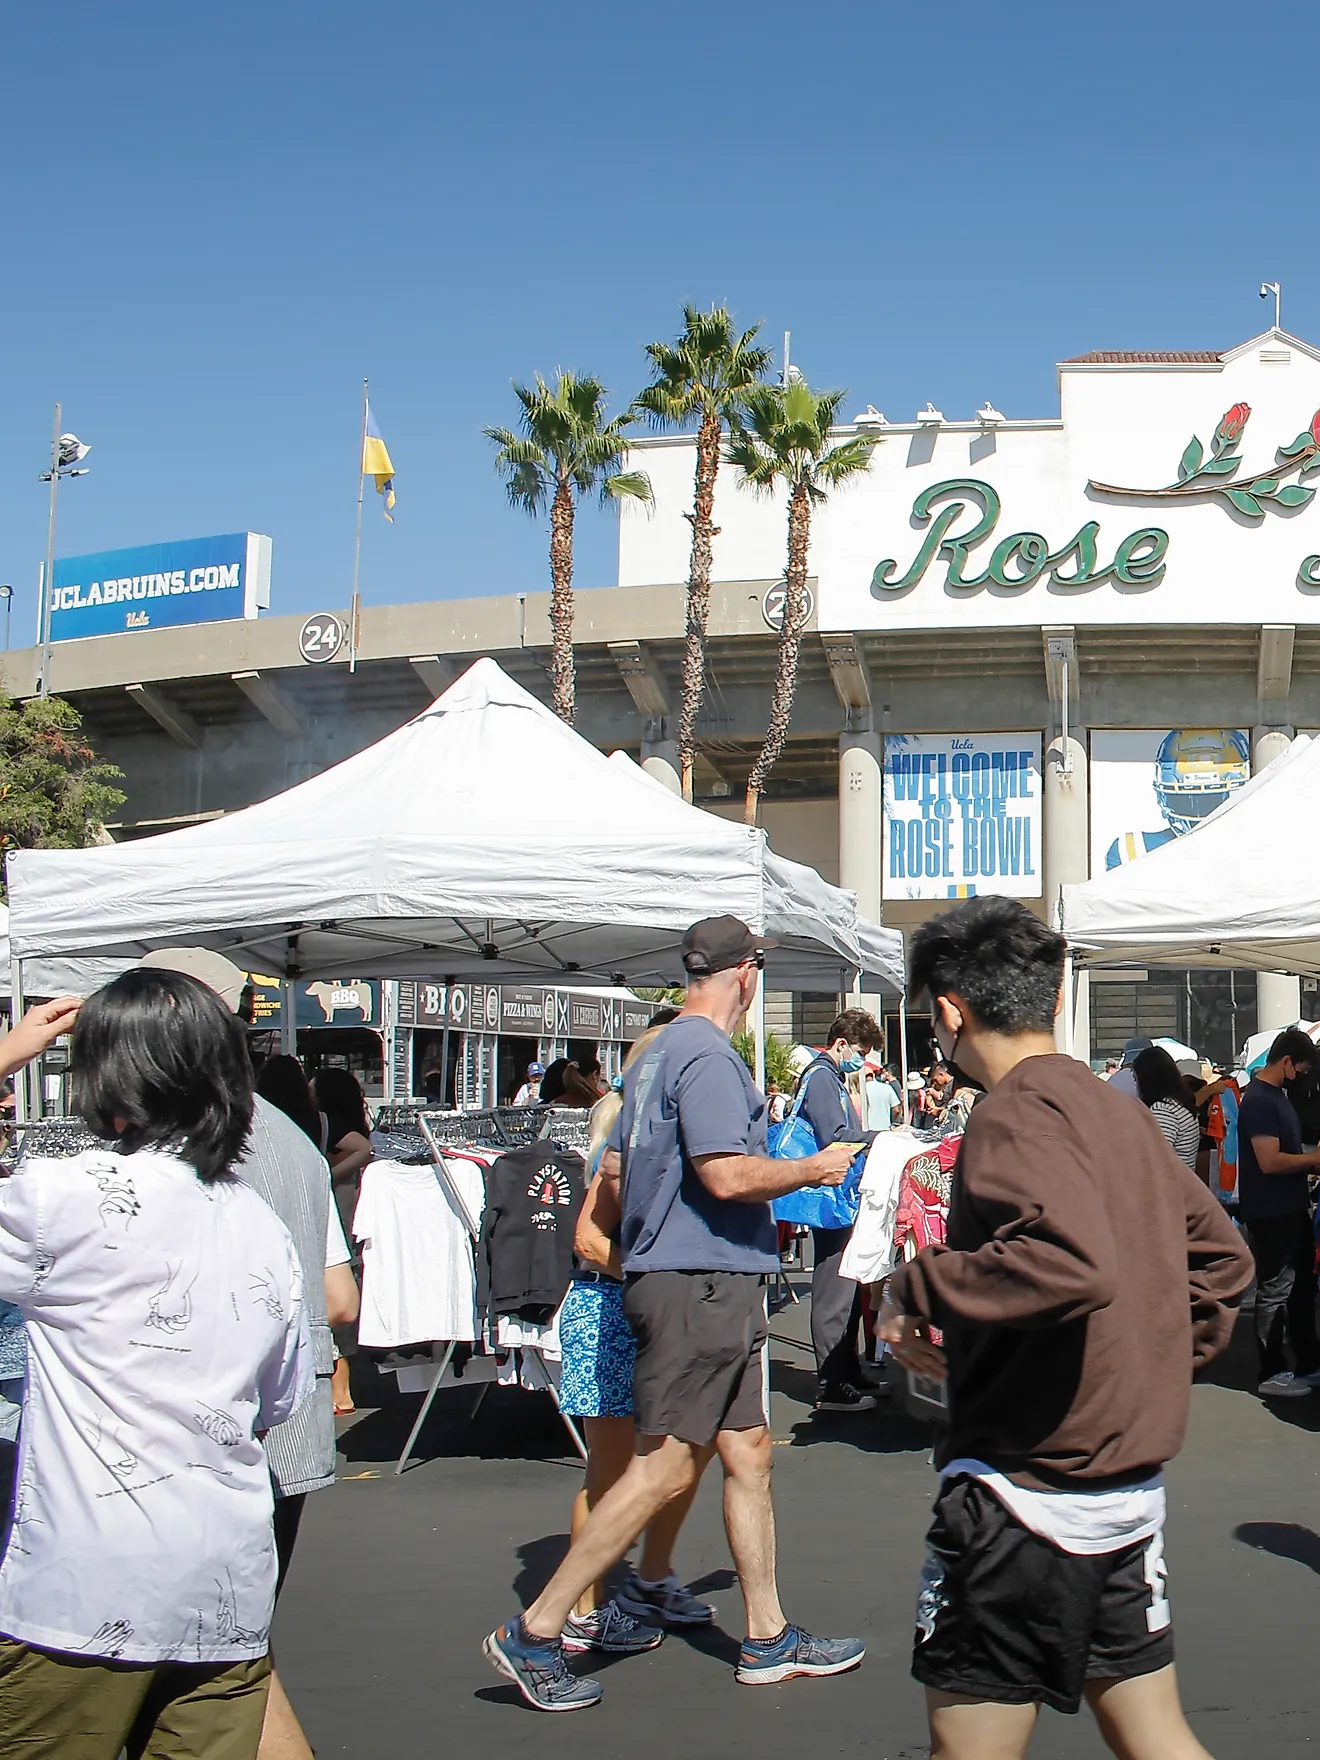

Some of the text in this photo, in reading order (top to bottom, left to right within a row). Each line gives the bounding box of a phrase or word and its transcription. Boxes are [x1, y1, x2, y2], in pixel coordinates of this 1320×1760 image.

[872, 478, 1170, 590] Rose
[303, 623, 337, 652] 24
[951, 738, 974, 750] Ucla
[891, 751, 1033, 801] WELCOME
[919, 798, 1007, 819] TO THE
[890, 816, 1035, 878] ROSE BOWL
[331, 988, 360, 1004] BBQ
[503, 1002, 521, 1017] PIZZA
[527, 1163, 572, 1206] PLAYSTATION
